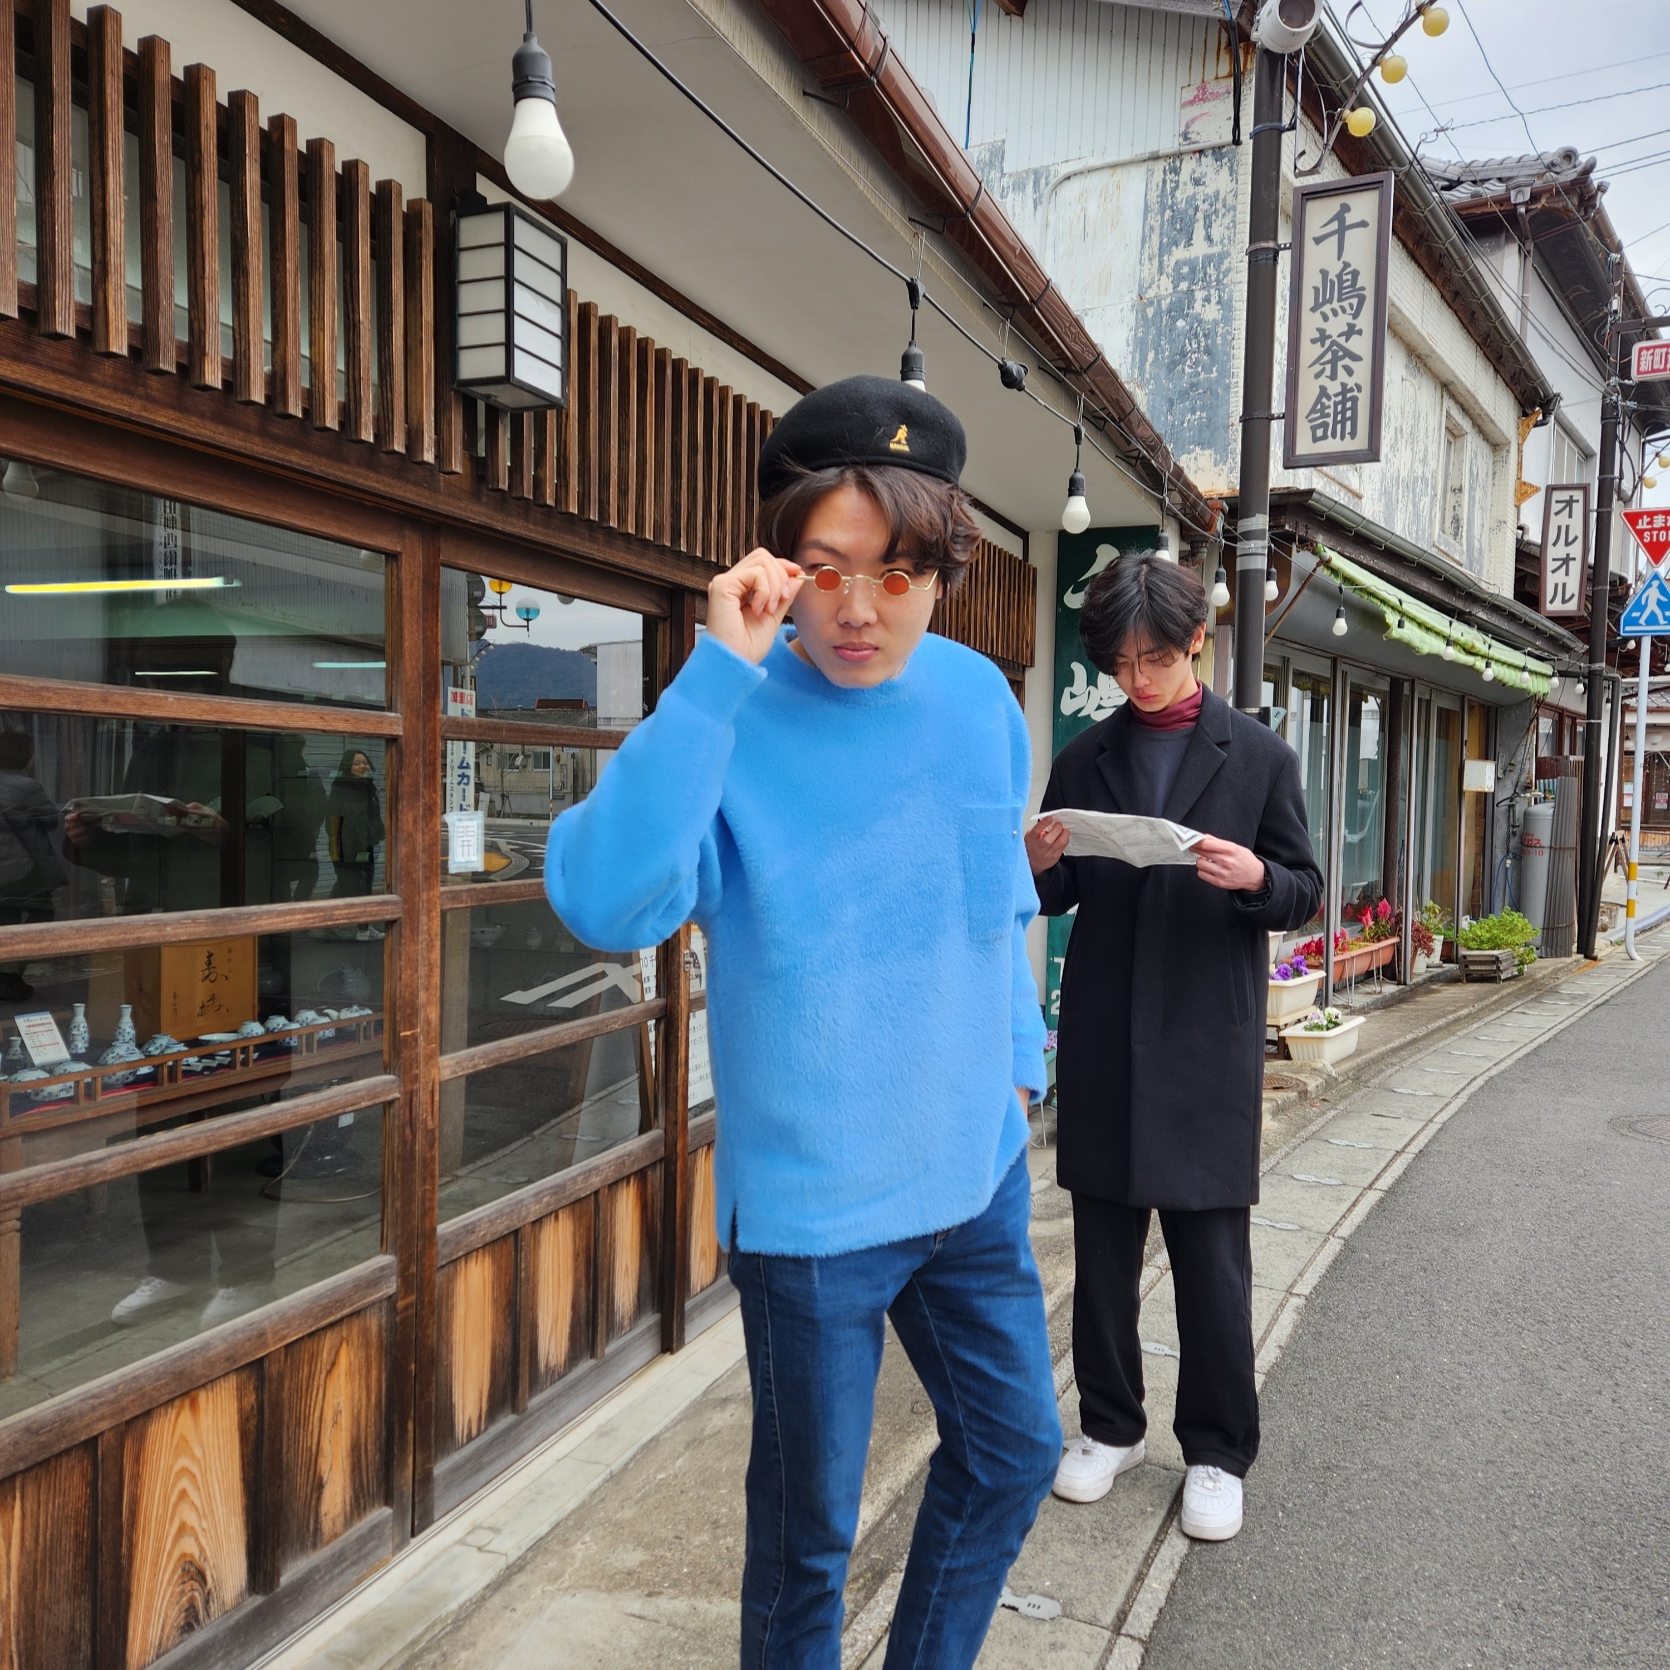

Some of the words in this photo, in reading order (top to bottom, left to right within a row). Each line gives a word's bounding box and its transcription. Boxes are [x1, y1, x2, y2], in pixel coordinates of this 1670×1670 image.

[1305, 202, 1370, 444] 千嶋茶舗
[1548, 495, 1580, 606] オルオル
[455, 825, 476, 858] 開
